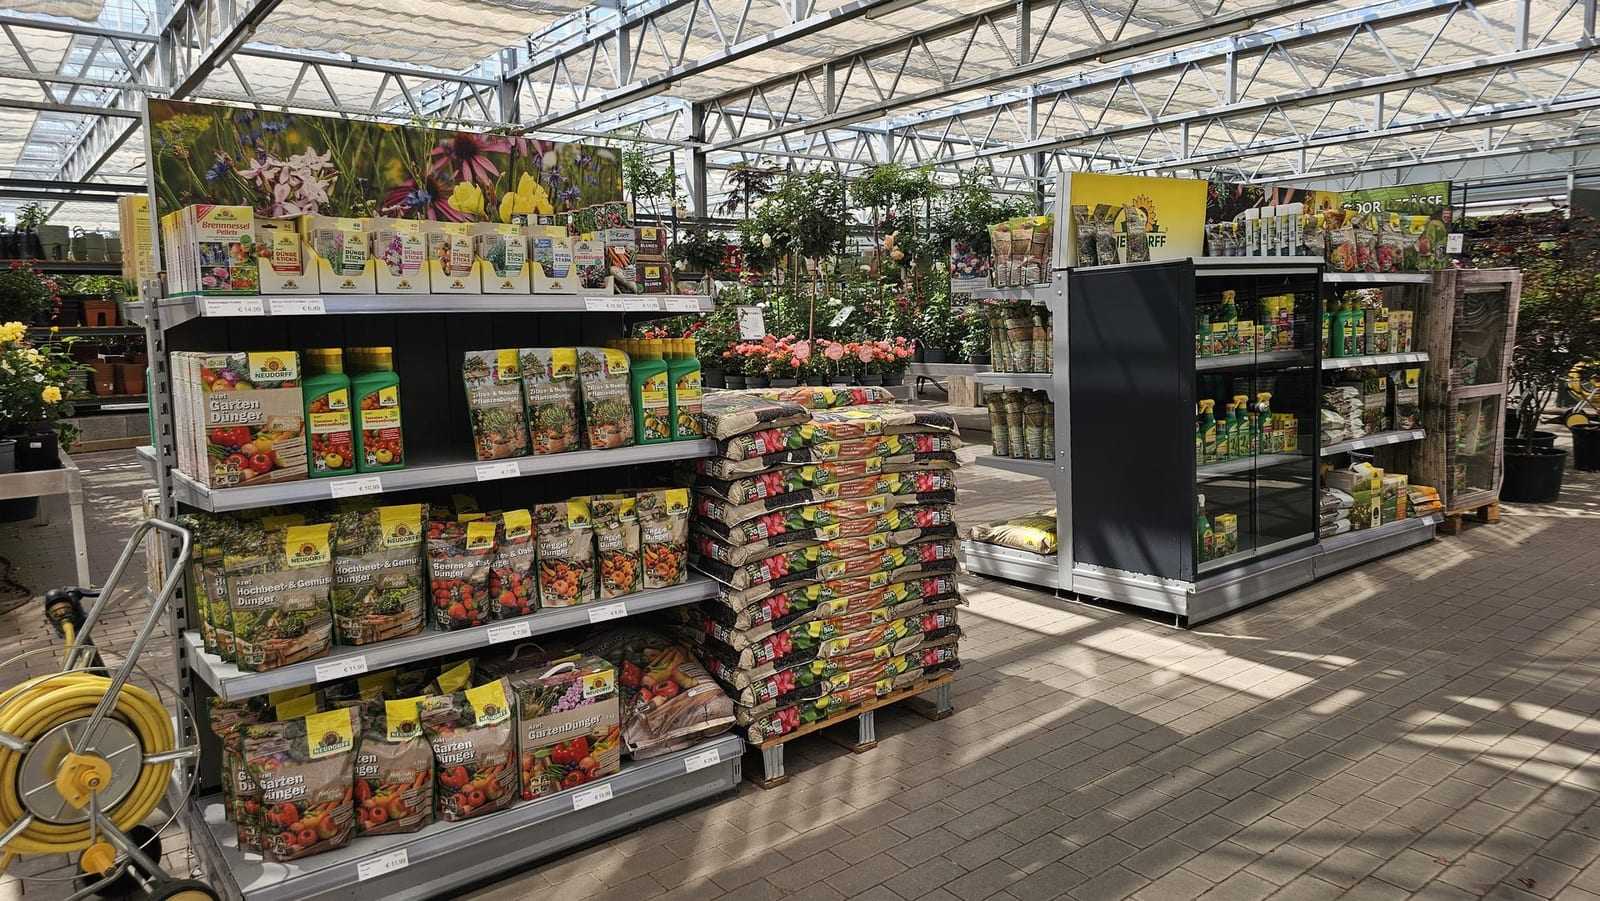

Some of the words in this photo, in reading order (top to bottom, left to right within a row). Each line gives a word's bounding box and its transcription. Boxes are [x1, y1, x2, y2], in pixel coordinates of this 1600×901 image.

[202, 222, 250, 231] Brennnessel
[210, 400, 261, 412] Garten
[210, 411, 263, 423] Dünger
[387, 535, 419, 545] NEUDORFF
[291, 555, 326, 563] NEUDORFF
[385, 559, 391, 568] &
[337, 573, 371, 585] Dünger
[434, 570, 464, 580] Dünger
[288, 581, 297, 590] &
[238, 595, 275, 608] Dünger
[528, 713, 602, 740] GartenDünger
[433, 740, 473, 754] Garten
[357, 753, 377, 763] ten
[260, 774, 304, 791] Garten
